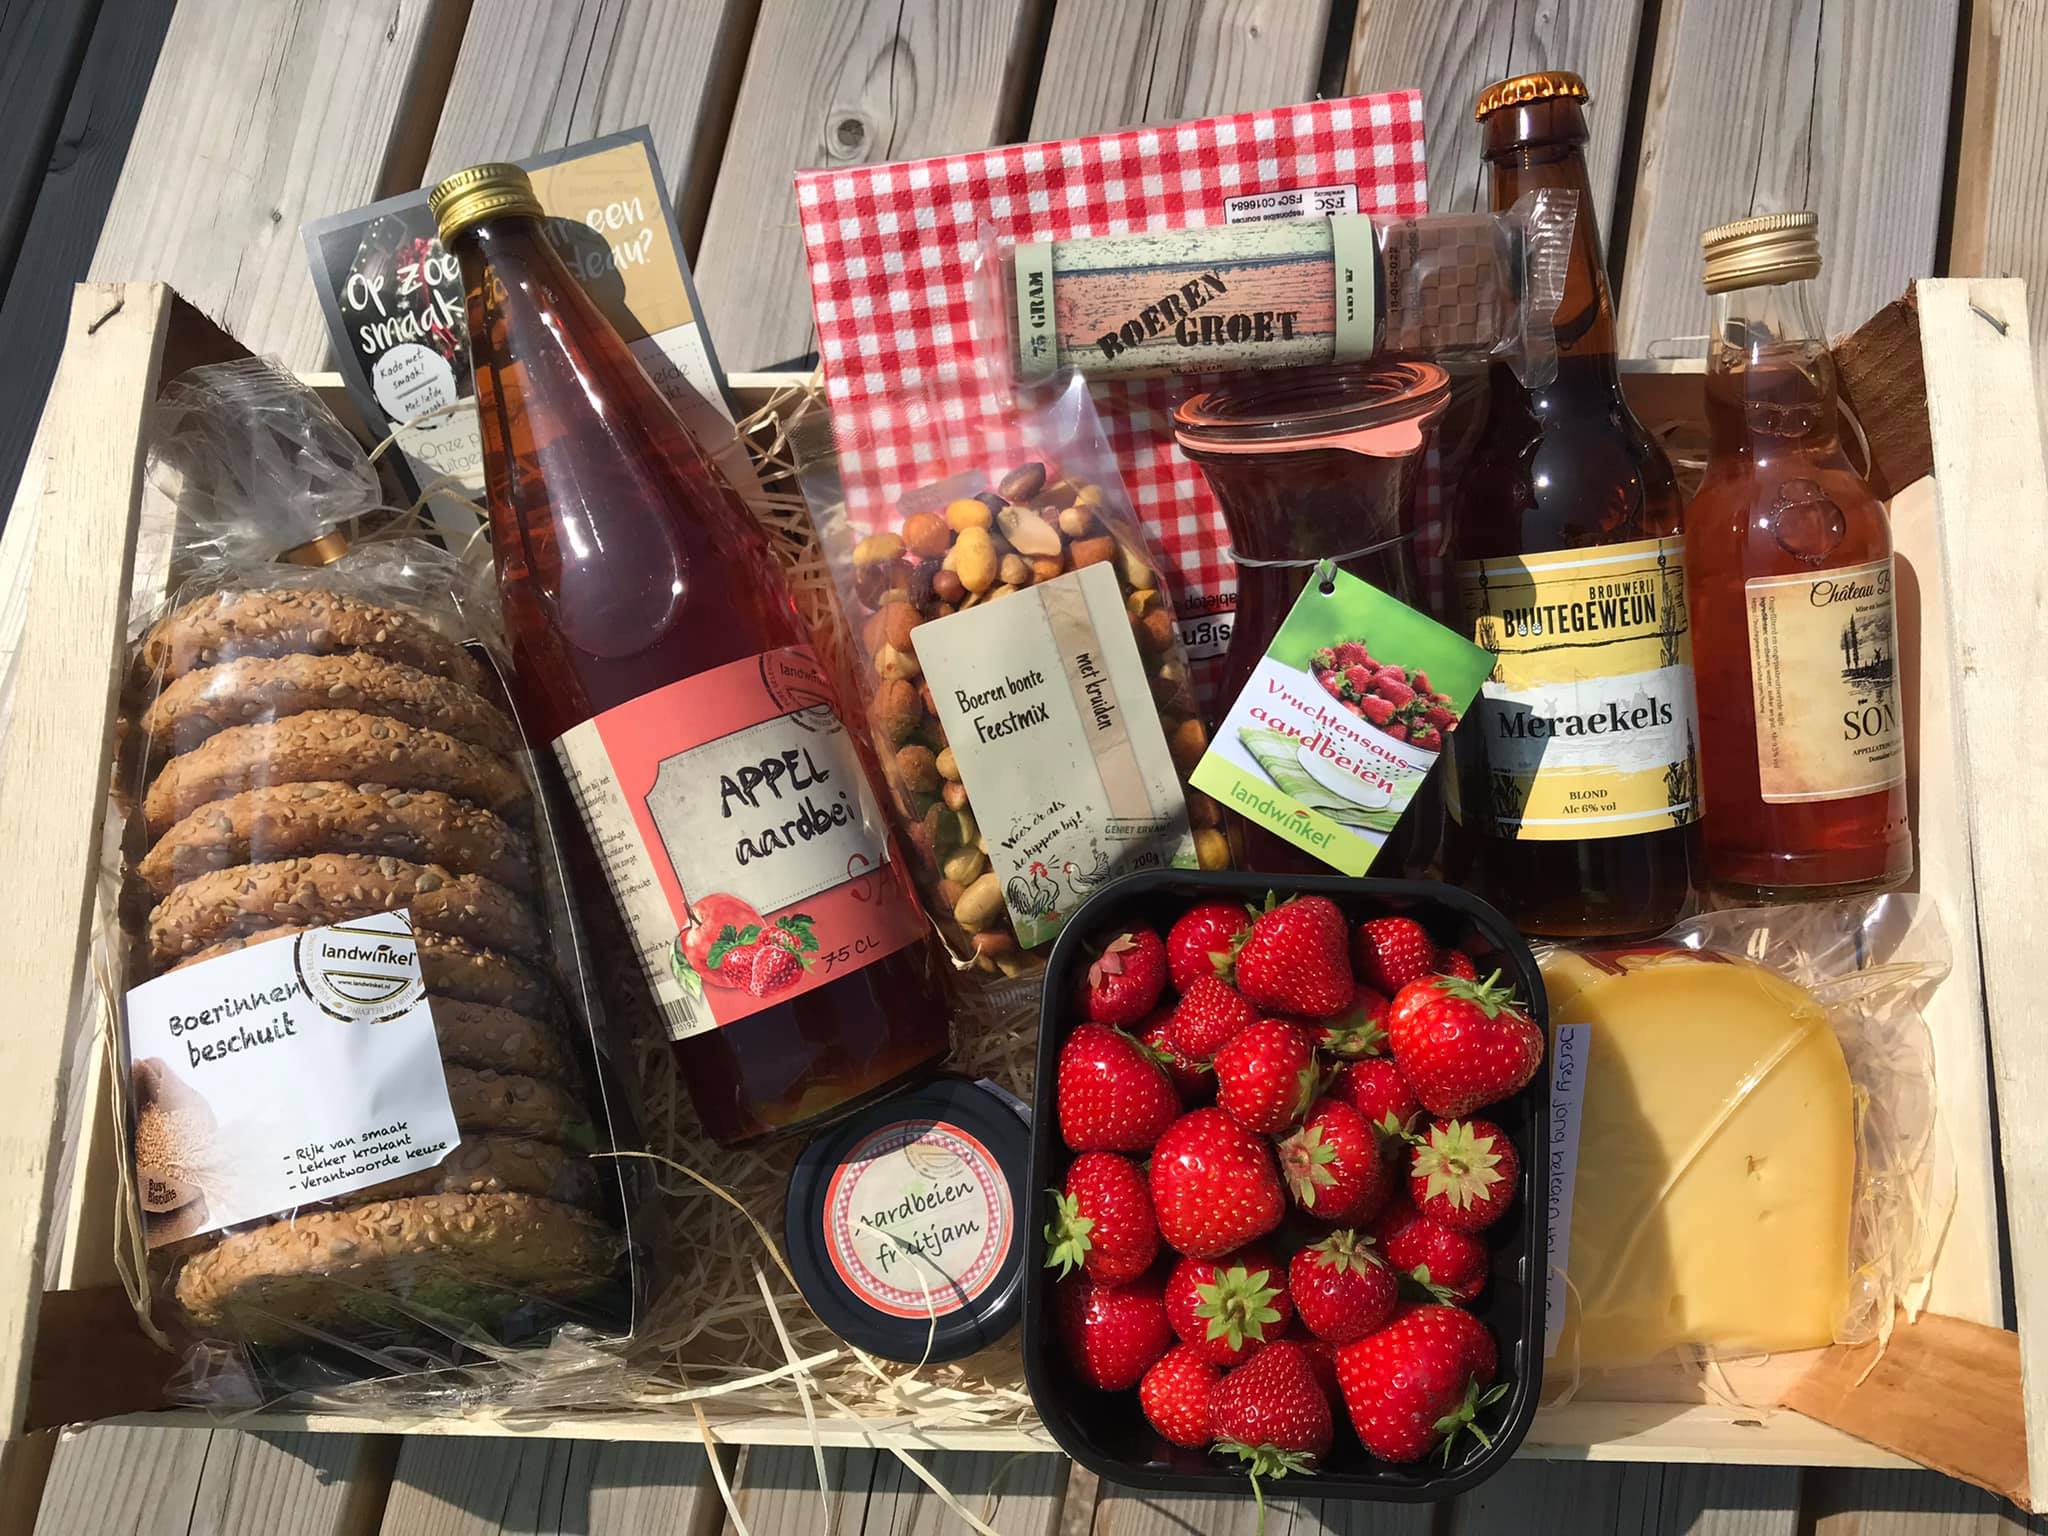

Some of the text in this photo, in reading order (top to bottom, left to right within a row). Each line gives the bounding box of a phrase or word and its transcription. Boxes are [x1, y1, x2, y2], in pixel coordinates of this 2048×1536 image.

[1231, 198, 1276, 212] C016684
[1263, 210, 1304, 221] responsible
[1315, 197, 1345, 210] FSC
[347, 273, 386, 317] Op
[586, 197, 644, 233] een
[1029, 271, 1048, 358] 75 GRAM
[1097, 270, 1229, 360] BOEREN
[1175, 311, 1300, 347] GROET
[406, 347, 424, 366] met
[420, 437, 464, 459] Onze
[1589, 579, 1654, 600] BROUWERIJ
[1810, 580, 1874, 608] Château
[1182, 621, 1231, 648] sign
[1503, 594, 1656, 638] BUUTEGEWEUN
[955, 670, 1045, 714] Boeren bonte
[1076, 653, 1116, 731] met kruiden
[974, 702, 1050, 744] Feestmix
[1268, 677, 1409, 769] Vruchtensaus
[1497, 697, 1673, 738] Meraekels
[1249, 706, 1395, 794] aardbeien
[720, 747, 830, 818] APPEL
[1569, 789, 1608, 800] BLOND
[735, 791, 856, 866] aardbei
[1001, 800, 1066, 850] Wees er als
[1231, 781, 1333, 849] landwinkel
[1562, 802, 1617, 814] Alc 6% vol
[1013, 856, 1027, 871] de
[1023, 829, 1061, 860] kippen
[1105, 825, 1135, 834] GENIET
[1133, 852, 1160, 869] 200g
[322, 944, 414, 966] landwinkel
[821, 935, 881, 974] 75 CL
[338, 980, 391, 990] www.landwinkel.nl
[169, 982, 301, 1036] Boerinnen
[187, 1011, 297, 1068] beschuit
[1555, 1027, 1575, 1092] Jersey
[296, 1121, 409, 1161] Rijk van smaak
[1550, 1101, 1572, 1144] jong
[298, 1134, 412, 1175] Lekker krokant
[300, 1141, 447, 1190] Verantwoorde keuze
[149, 1179, 166, 1193] Busy
